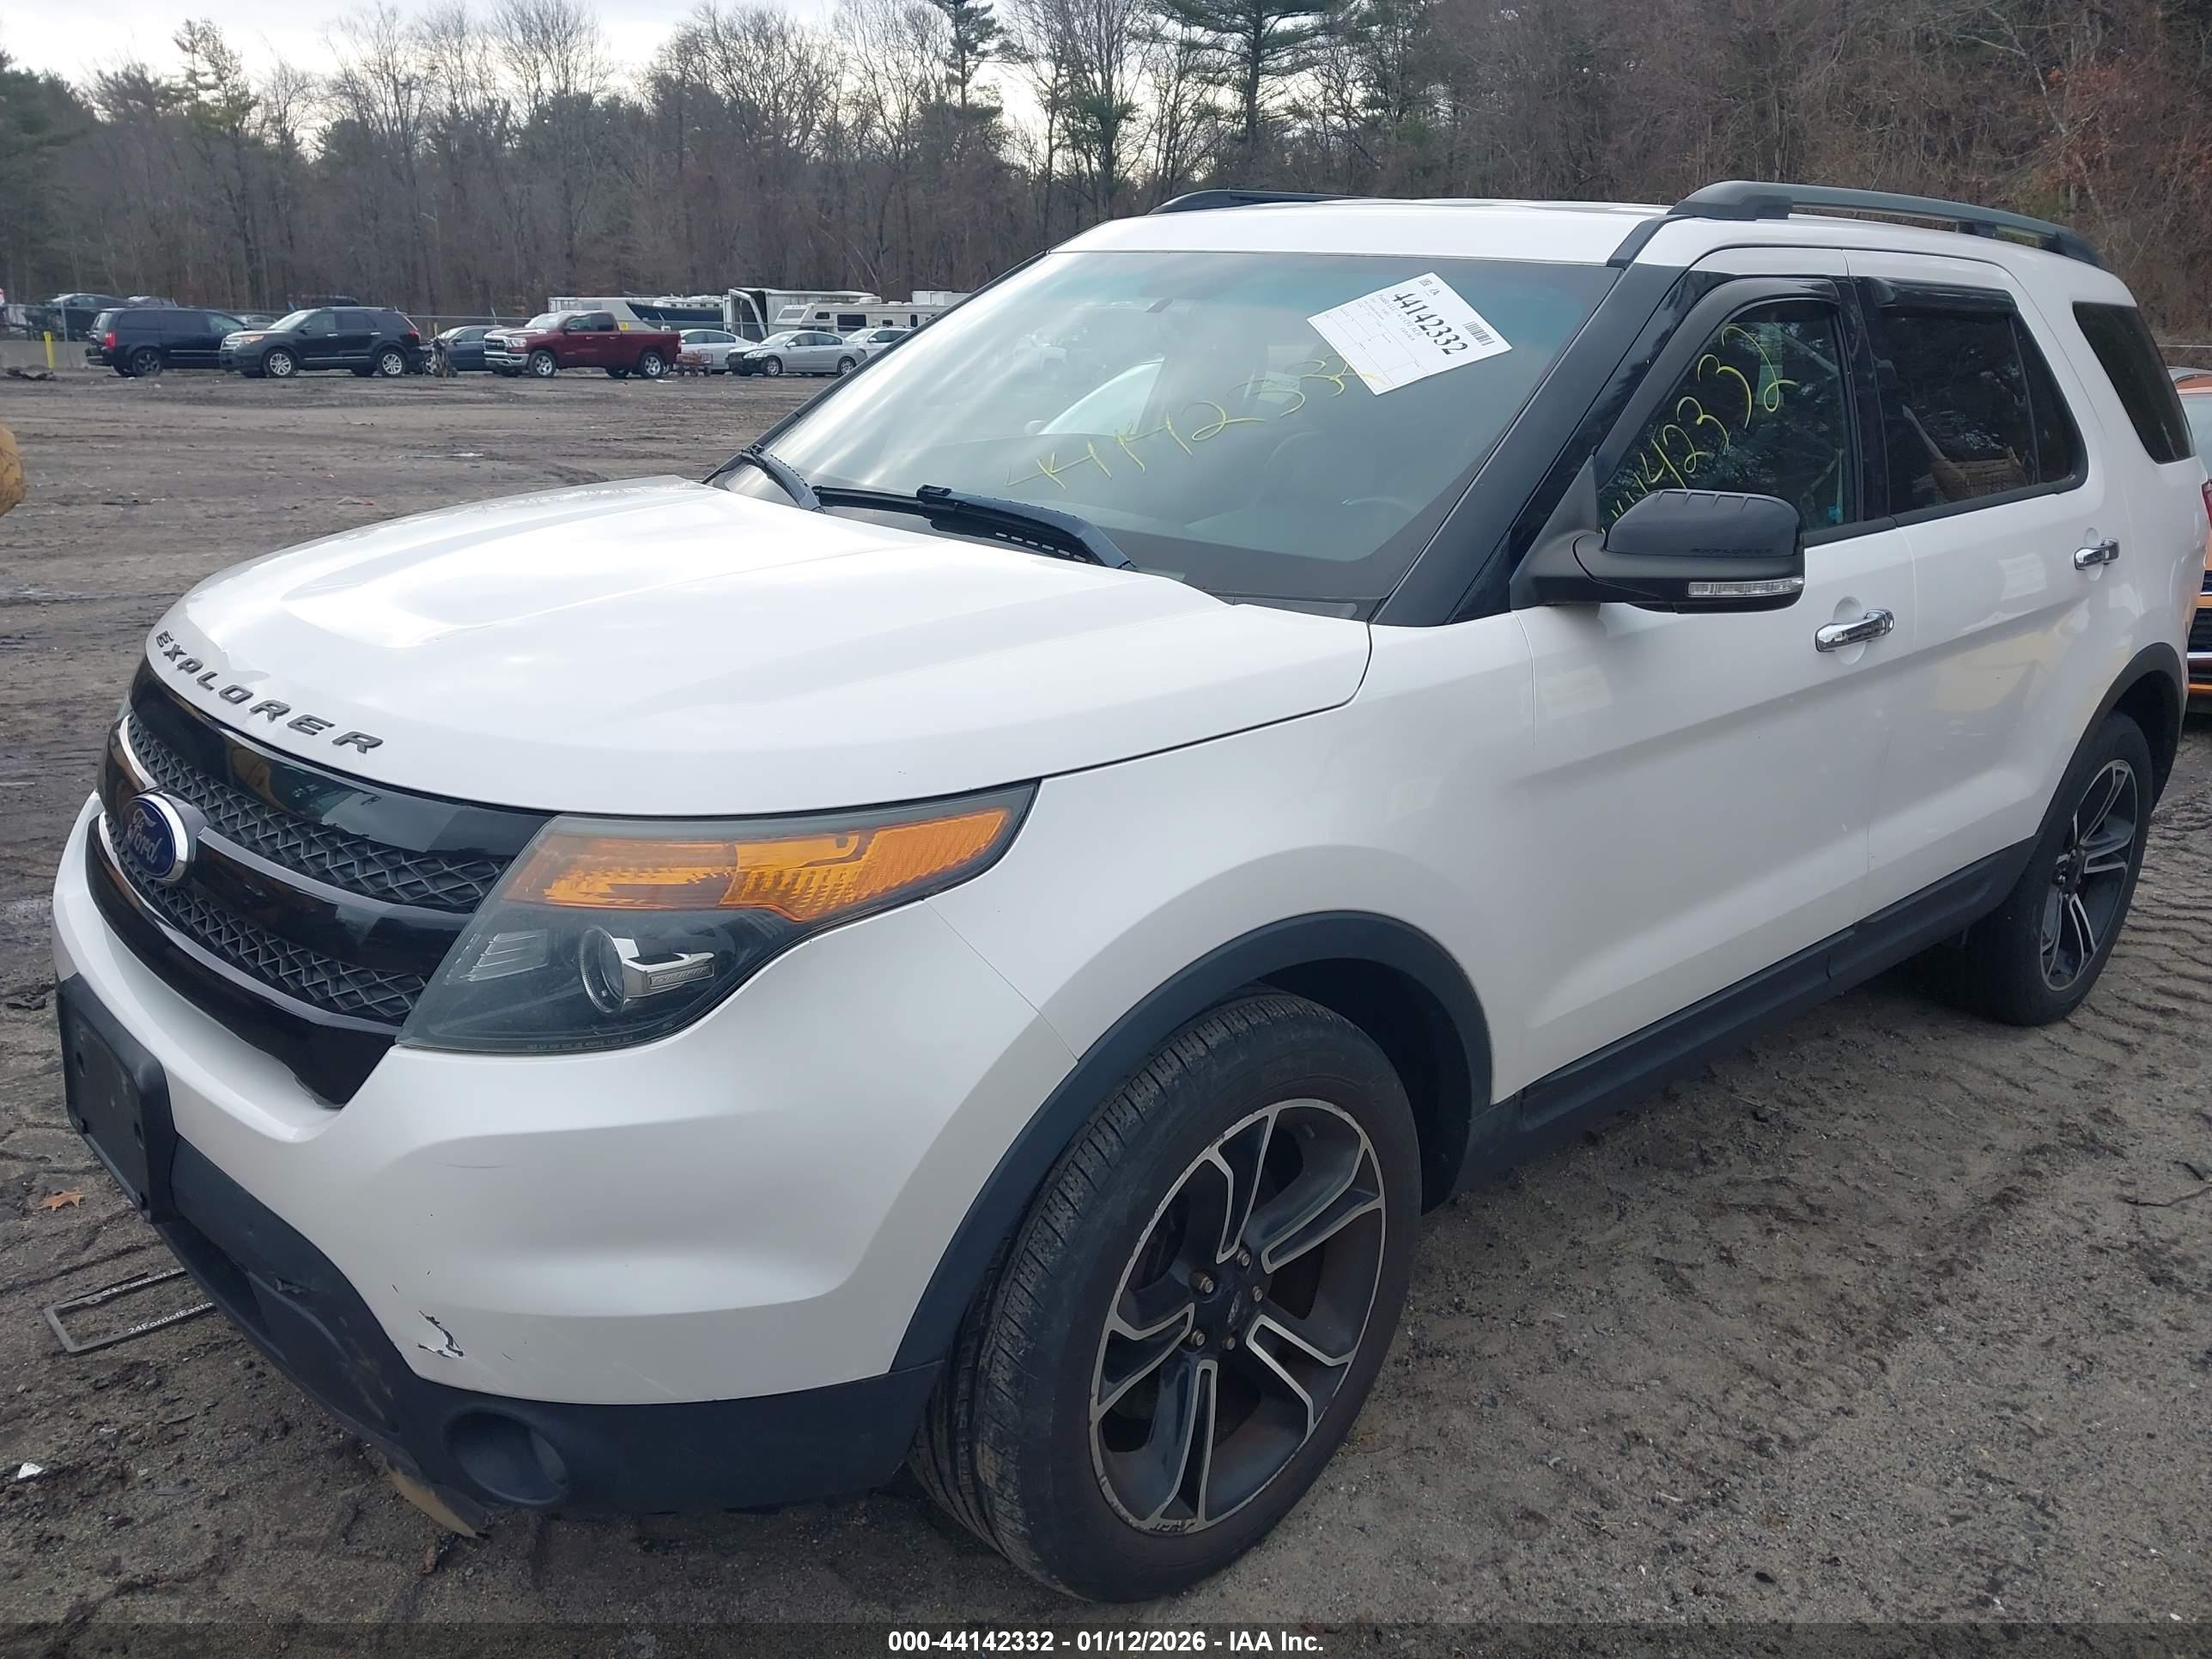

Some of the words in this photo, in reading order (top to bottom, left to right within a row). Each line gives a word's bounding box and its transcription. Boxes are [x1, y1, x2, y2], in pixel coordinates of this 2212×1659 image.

[1392, 293, 1468, 356] 44142332
[155, 629, 384, 754] EXPLORER
[126, 808, 163, 864] Ford
